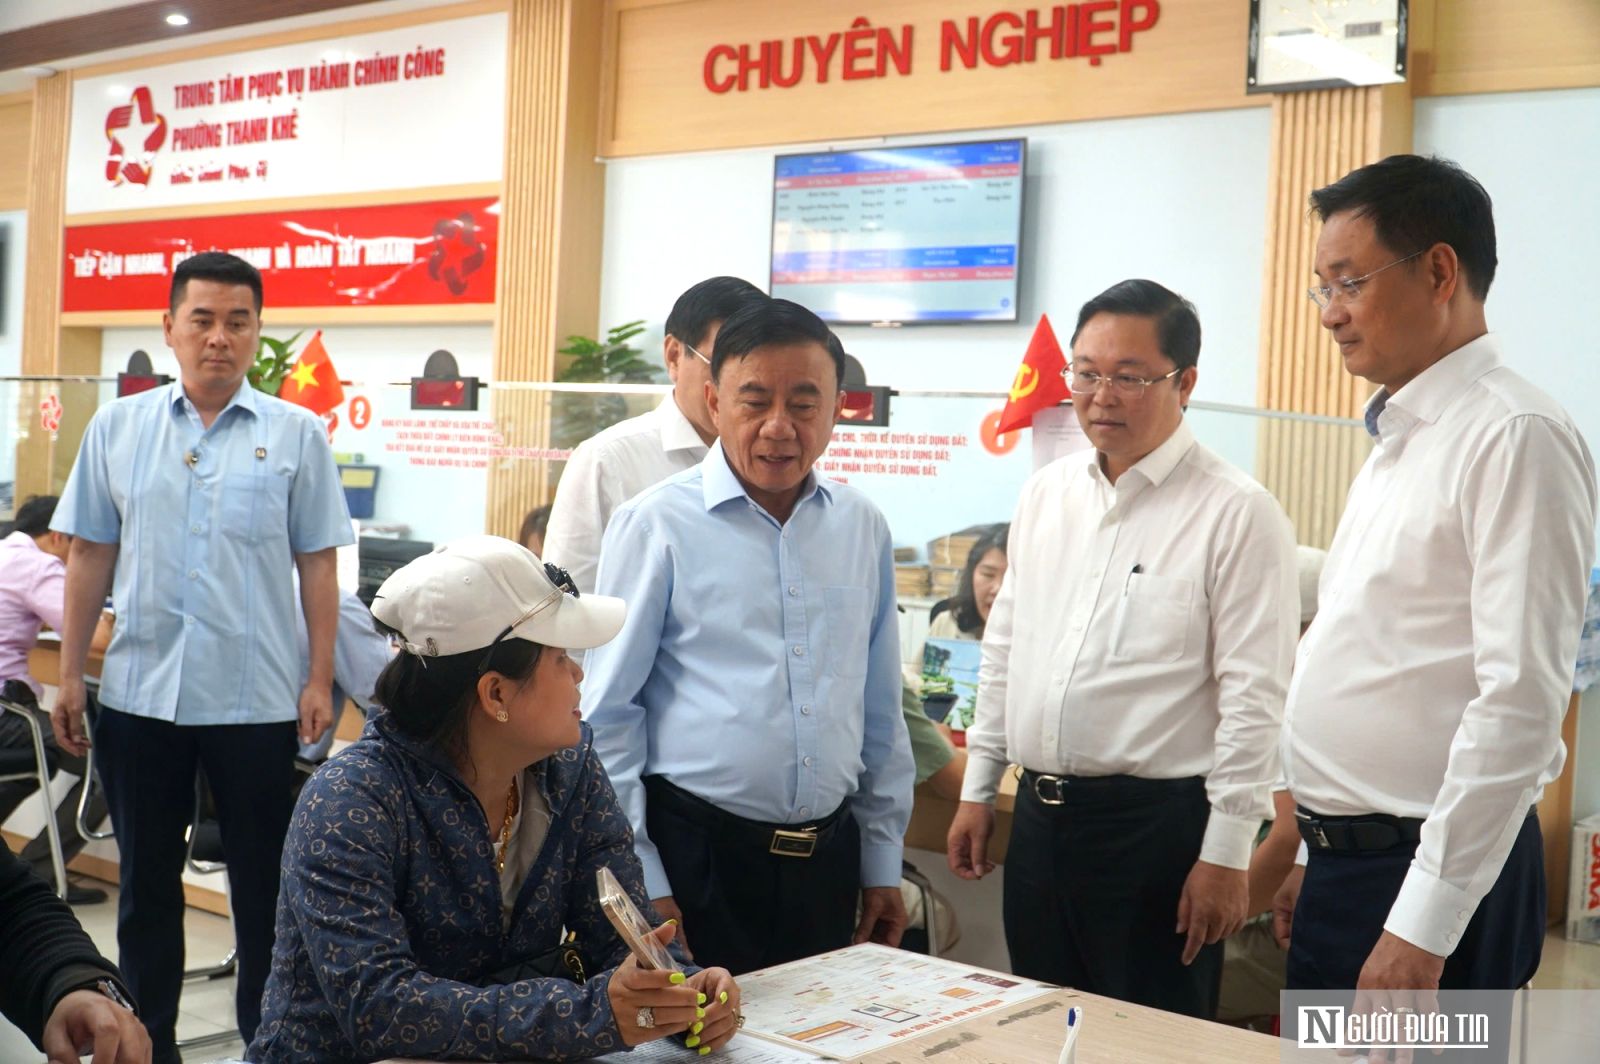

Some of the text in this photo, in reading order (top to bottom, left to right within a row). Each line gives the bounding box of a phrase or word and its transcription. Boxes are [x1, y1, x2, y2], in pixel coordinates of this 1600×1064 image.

[703, 0, 1161, 94] CHUYÊN NGHIỆP
[174, 45, 445, 110] TRUNG TÂM PHỤC VỤ HÀNH CHÍNH CÔNG
[172, 107, 298, 152] PHƯỜNG THANH KHÊ
[354, 401, 365, 425] 2
